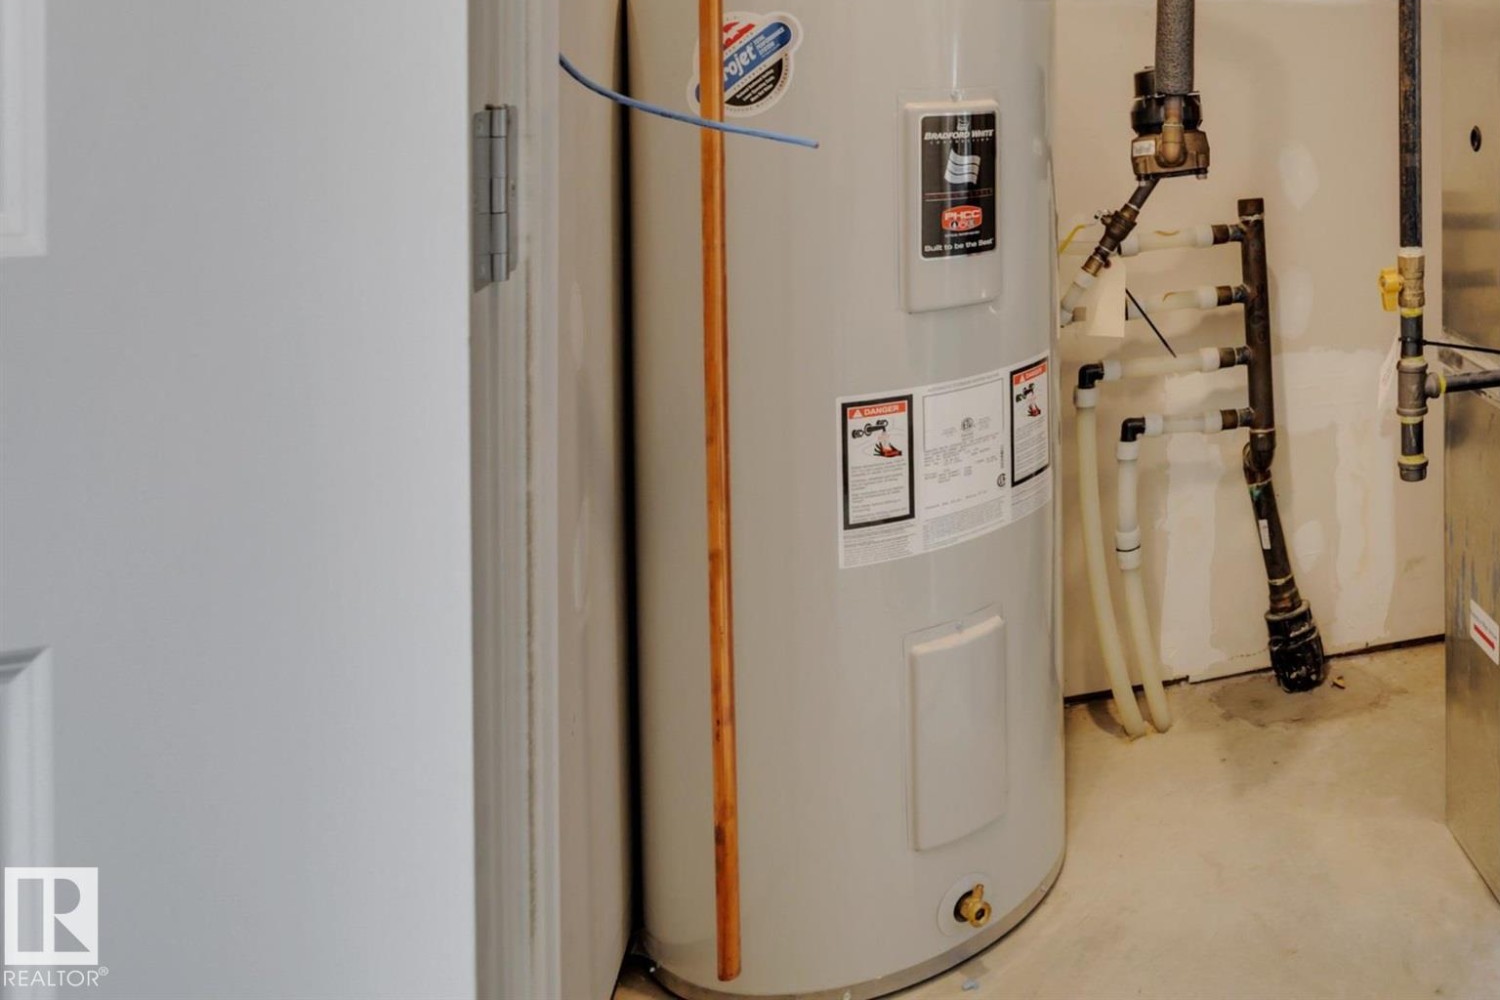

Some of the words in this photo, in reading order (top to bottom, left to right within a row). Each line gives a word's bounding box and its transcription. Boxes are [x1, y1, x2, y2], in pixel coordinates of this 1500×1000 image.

[723, 41, 757, 81] rojet
[924, 130, 970, 141] BRADFORD
[971, 128, 995, 138] WHITE
[943, 209, 981, 221] PHCC
[924, 244, 943, 252] Built
[944, 243, 953, 251] to
[954, 241, 965, 250] be
[965, 240, 978, 249] the
[978, 238, 994, 247] Best
[863, 405, 900, 417] DANGER
